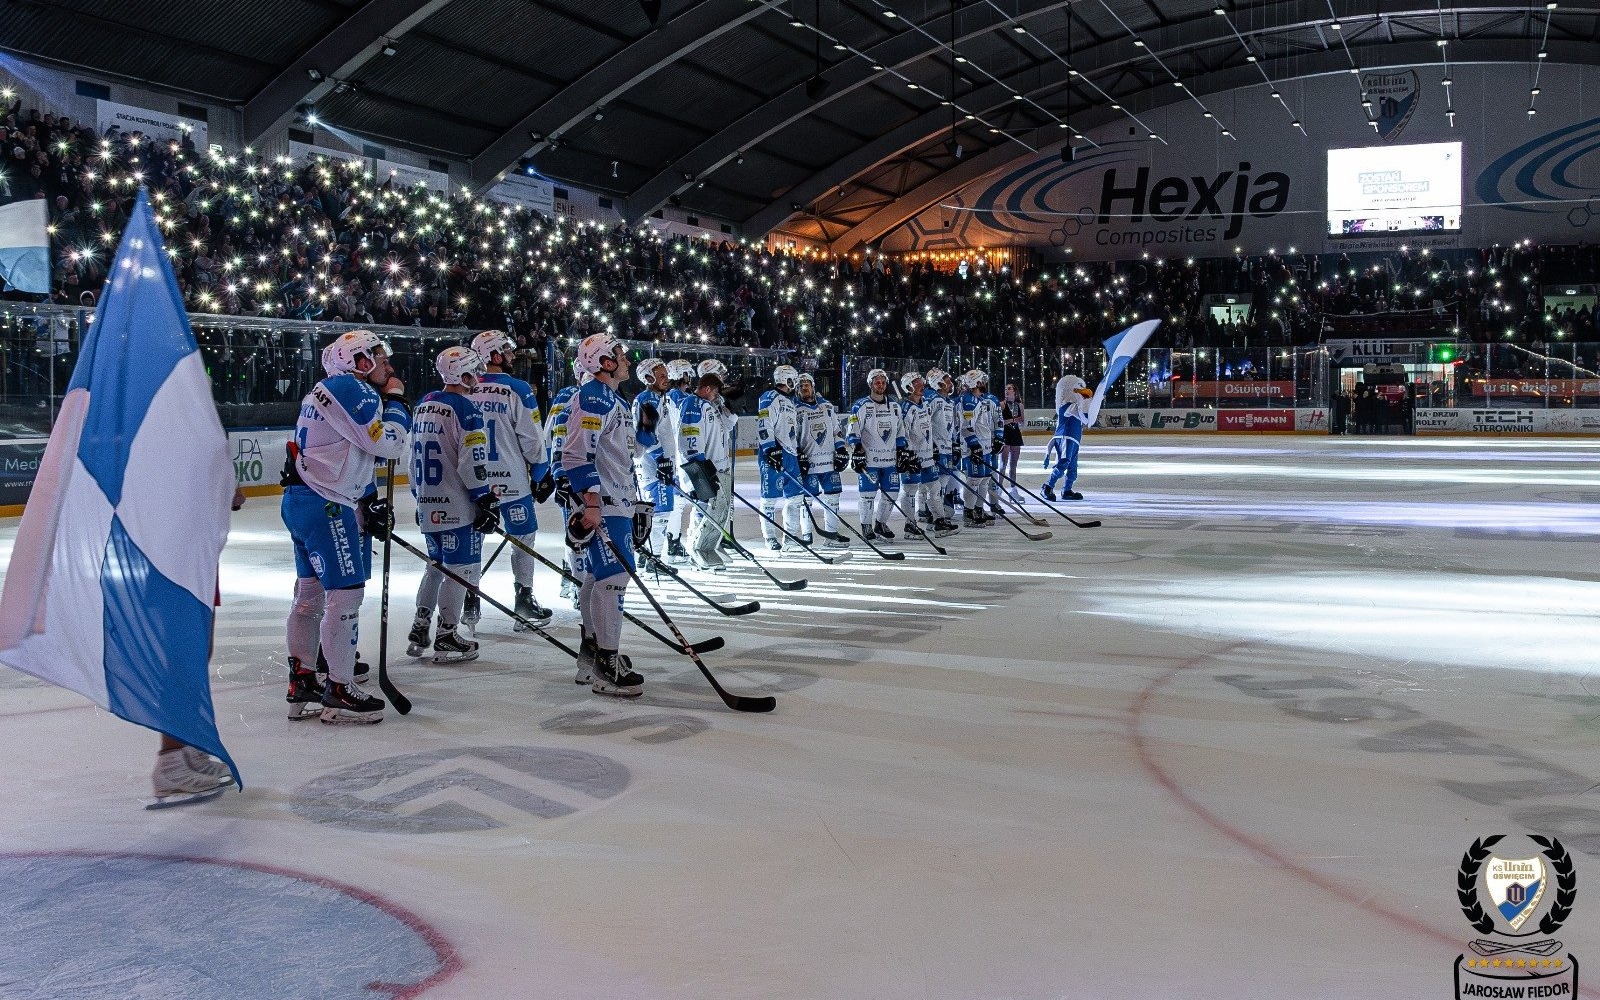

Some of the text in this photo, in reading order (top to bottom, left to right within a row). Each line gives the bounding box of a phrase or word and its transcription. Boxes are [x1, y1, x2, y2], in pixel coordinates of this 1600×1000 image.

[1359, 171, 1402, 183] ZOSTAŃ
[1363, 181, 1430, 194] SPONSOREM
[1098, 162, 1291, 240] Hexja
[1095, 226, 1217, 248] Composites
[1352, 340, 1393, 355] KLUB
[1224, 383, 1281, 397] Oświęcim
[1225, 413, 1287, 428] VIESSMANN
[1473, 410, 1534, 423] TECH
[1473, 424, 1534, 433] STEROWNIKI
[487, 419, 499, 461] 1
[687, 437, 697, 449] 72
[472, 446, 485, 461] 66
[333, 518, 356, 576] RE-PLAST
